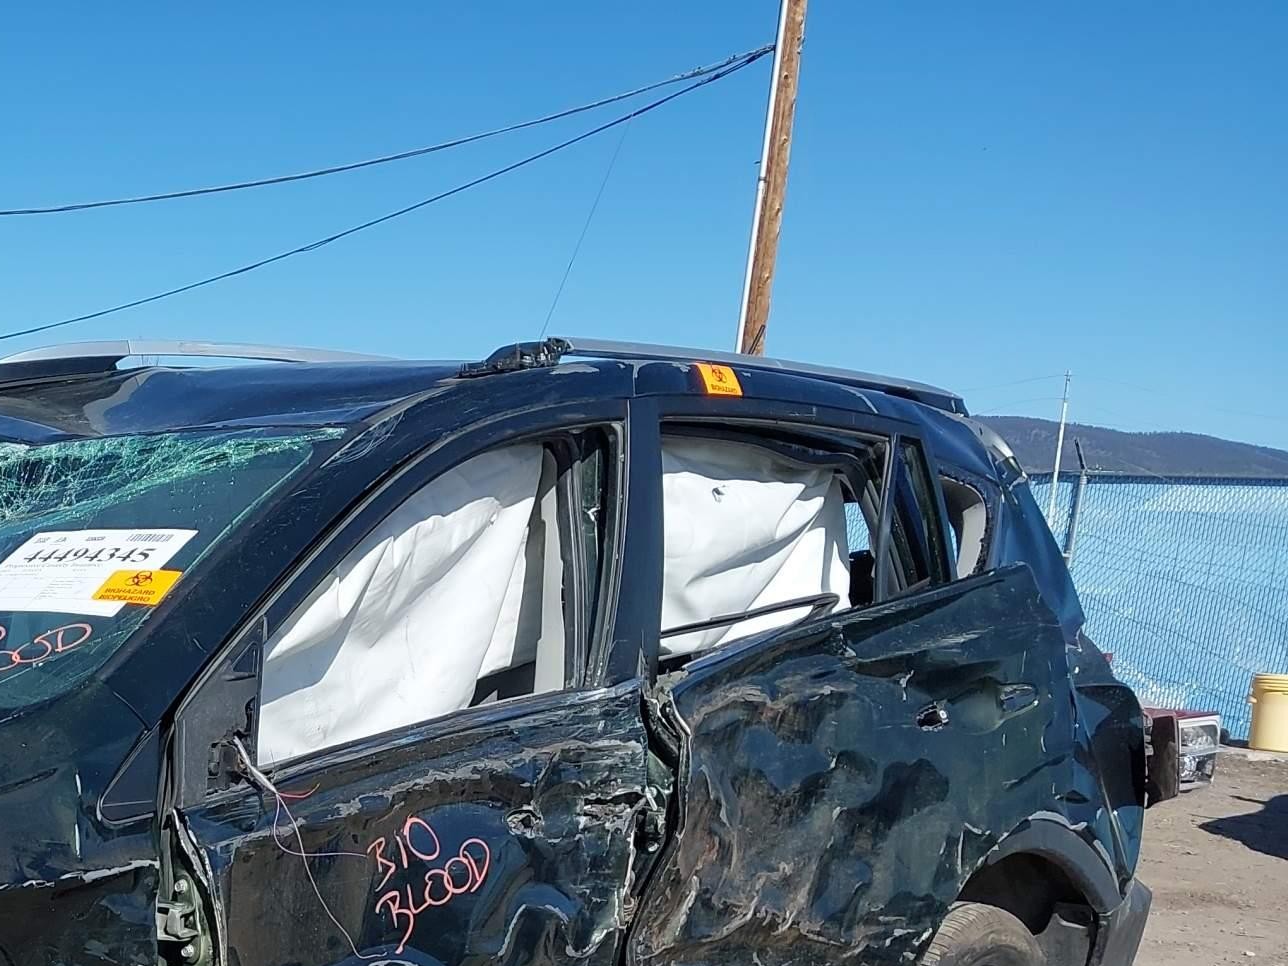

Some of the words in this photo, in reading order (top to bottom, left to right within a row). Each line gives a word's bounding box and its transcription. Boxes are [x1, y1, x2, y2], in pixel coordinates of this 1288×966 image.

[24, 547, 157, 563] 44494345
[104, 588, 155, 596] BIOHAZARD
[375, 838, 490, 954] BLOOD
